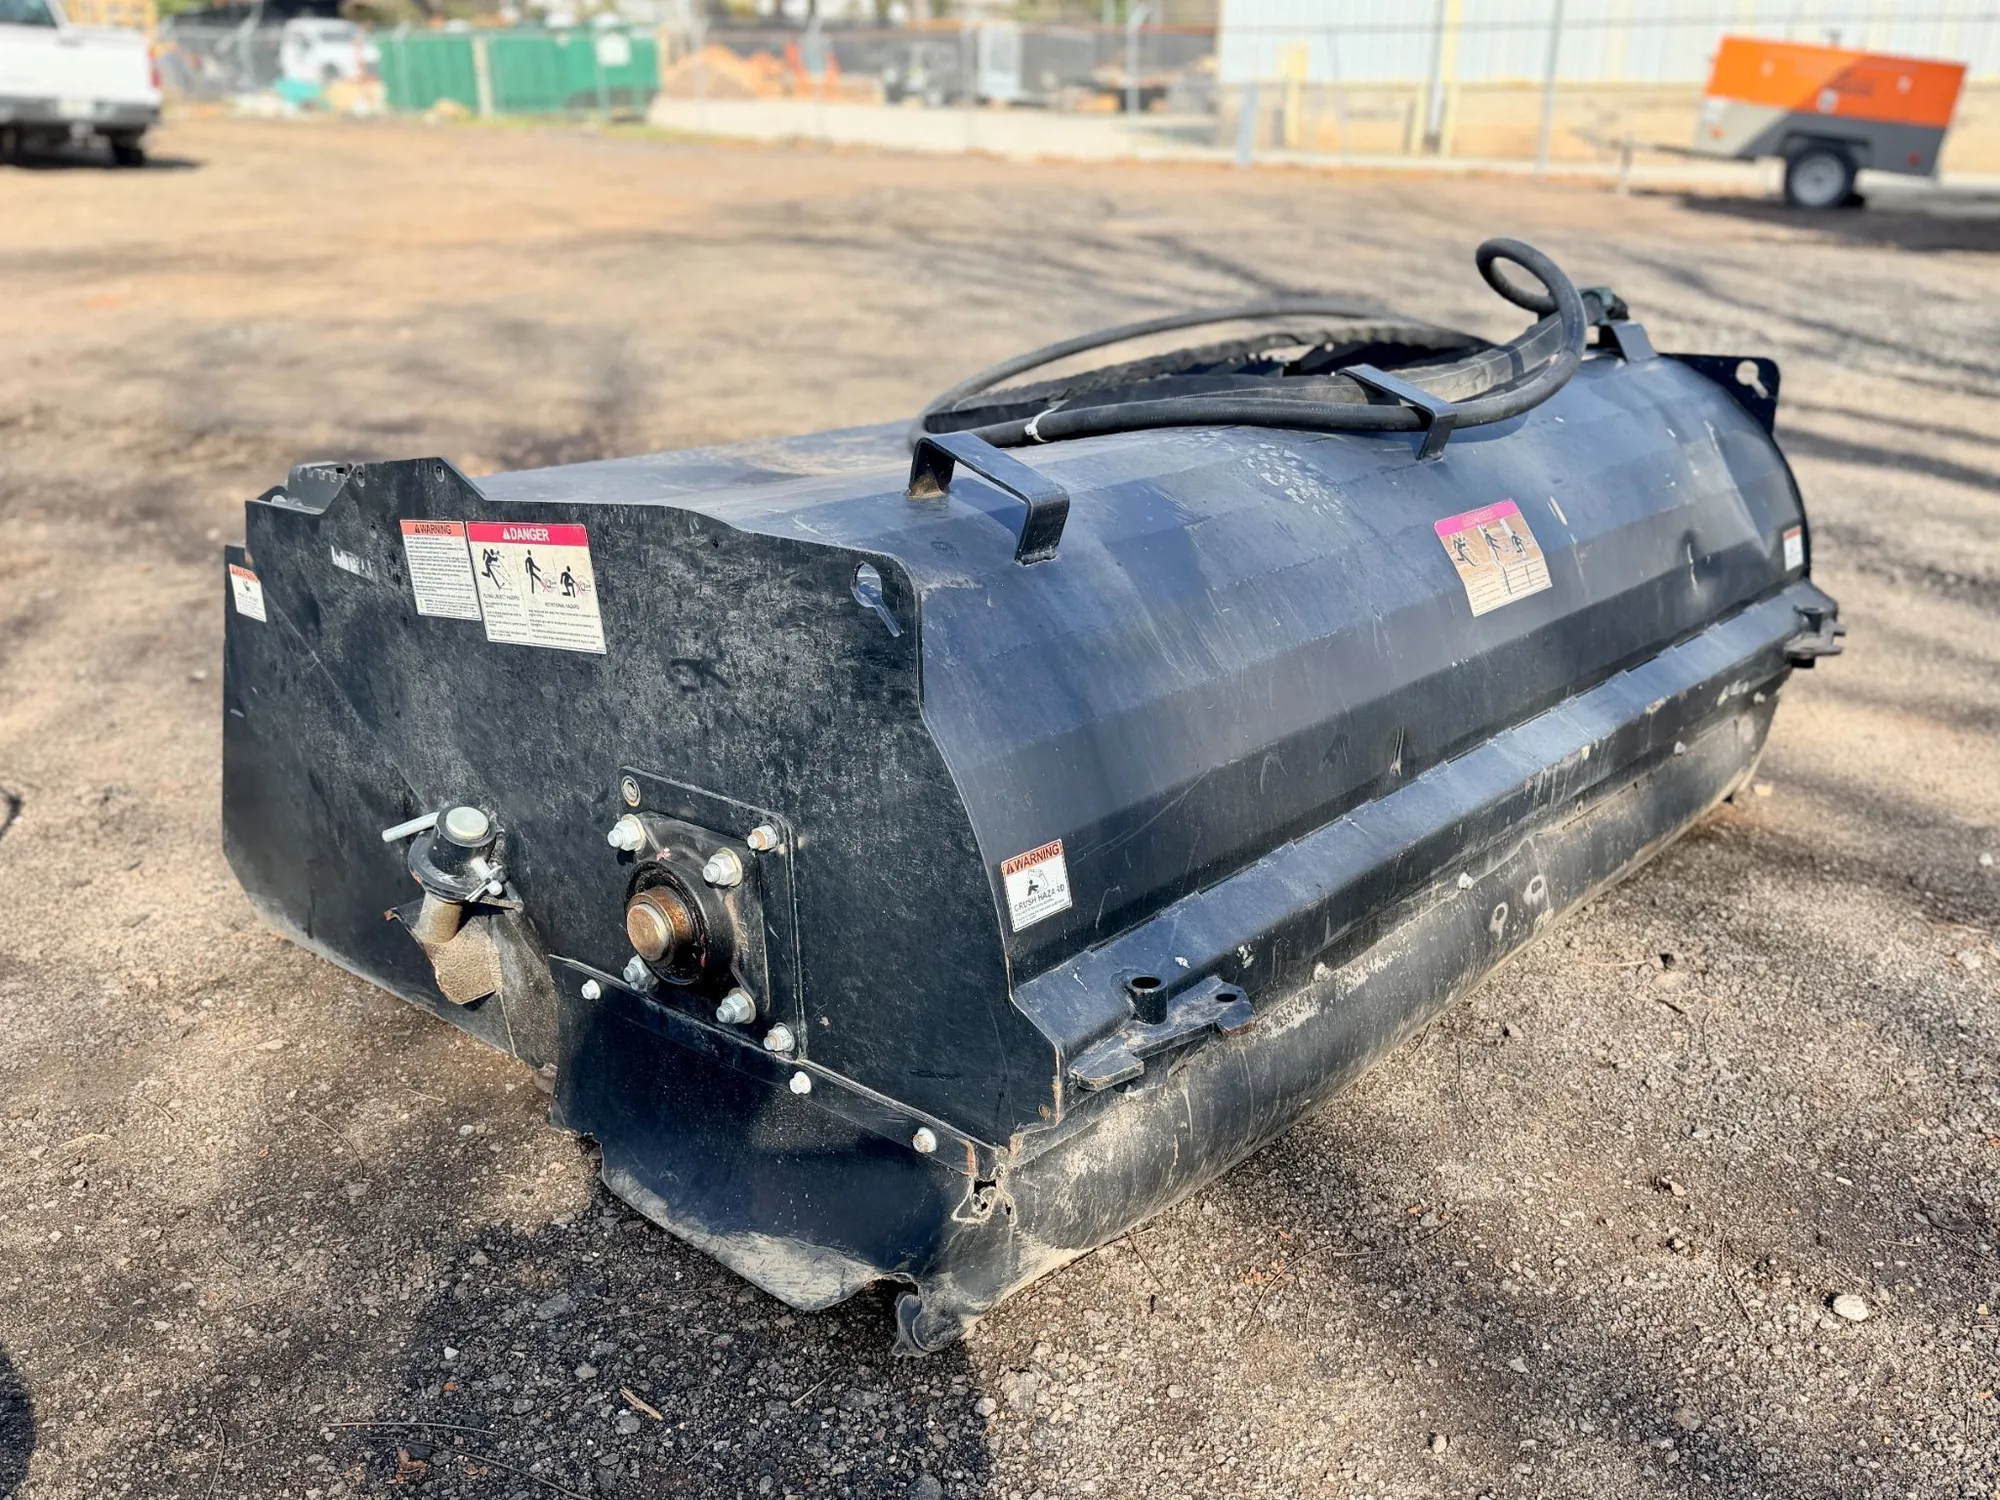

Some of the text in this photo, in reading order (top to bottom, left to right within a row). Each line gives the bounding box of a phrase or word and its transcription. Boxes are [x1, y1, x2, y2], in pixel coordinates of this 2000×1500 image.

[419, 524, 452, 535] WARNING
[510, 527, 550, 541] DANGER
[1014, 844, 1060, 870] WARNING
[1014, 895, 1037, 912] CRUSH
